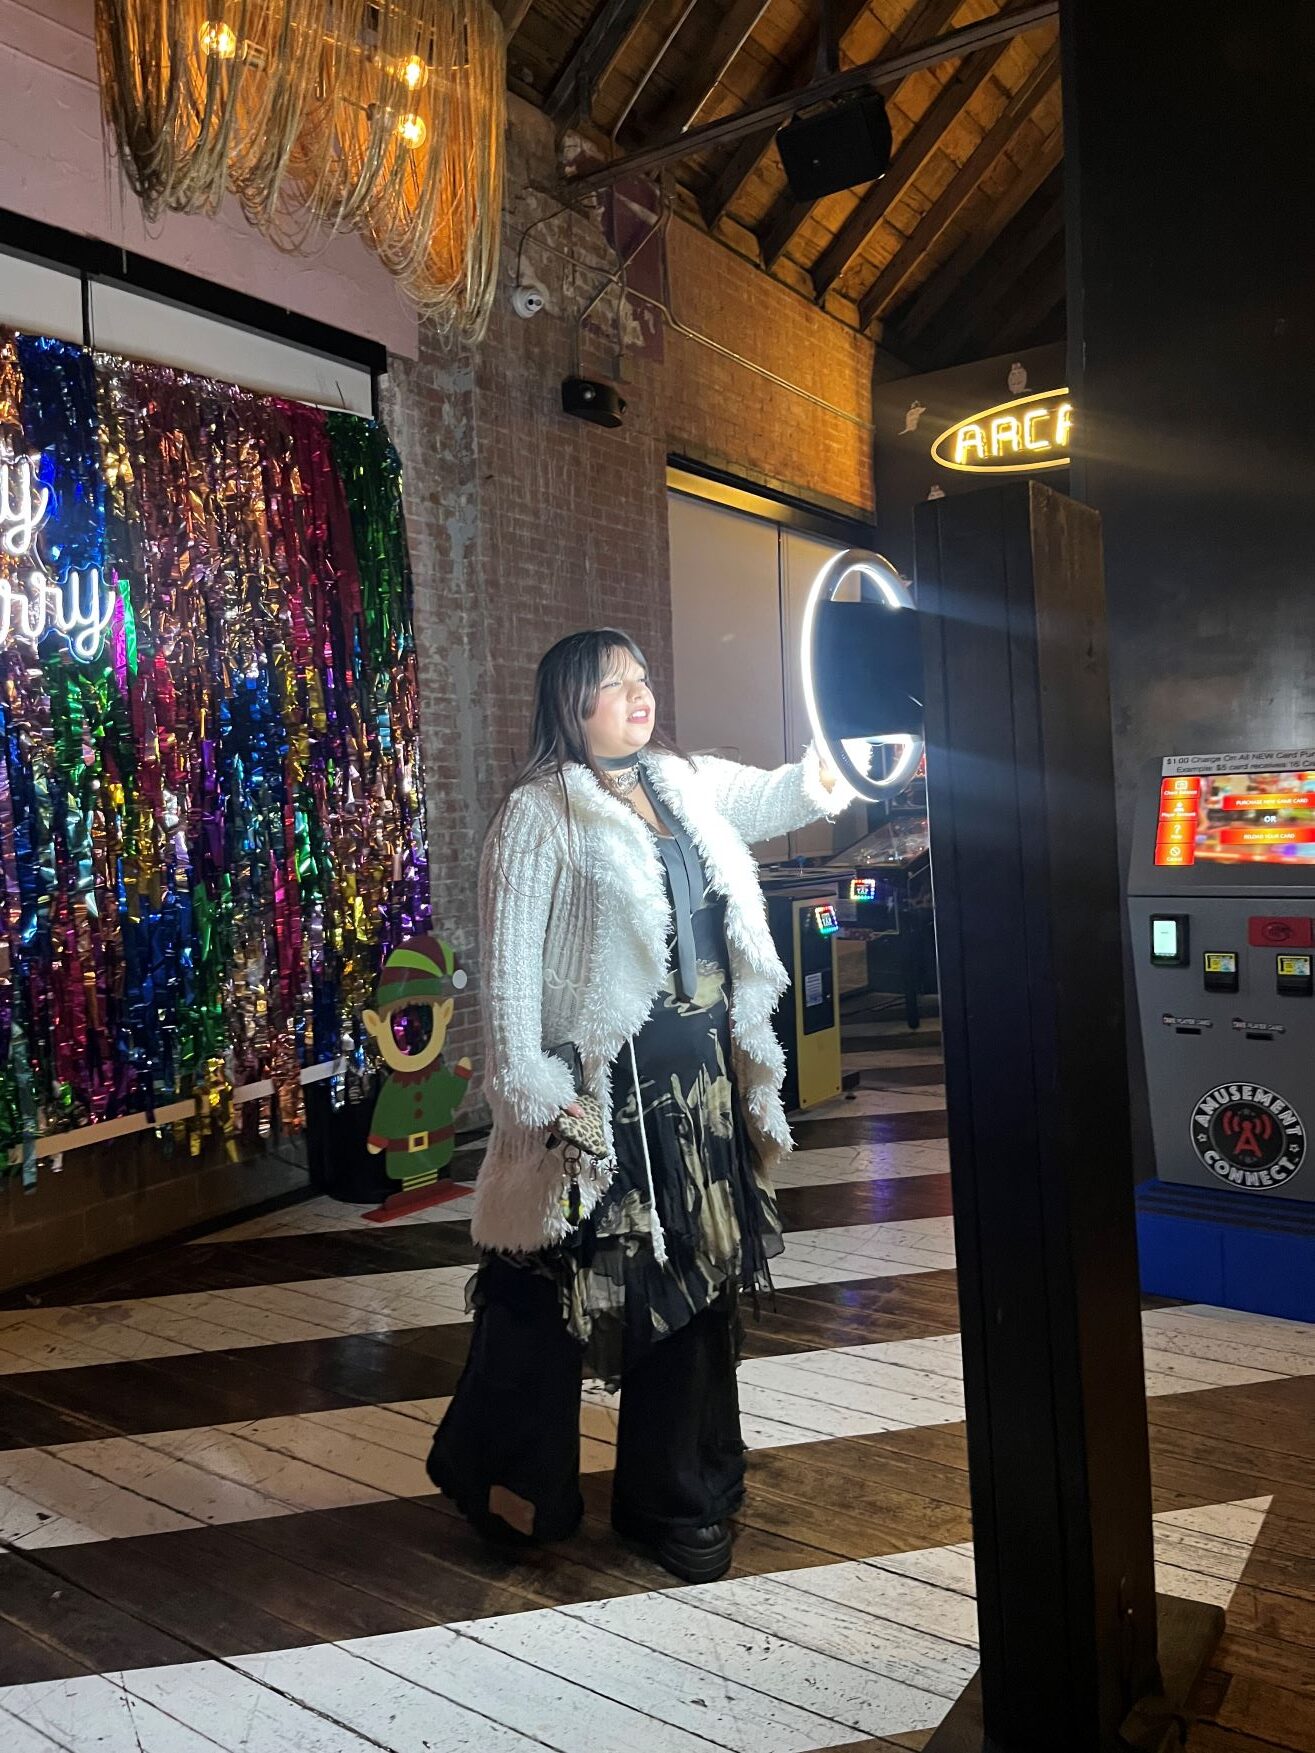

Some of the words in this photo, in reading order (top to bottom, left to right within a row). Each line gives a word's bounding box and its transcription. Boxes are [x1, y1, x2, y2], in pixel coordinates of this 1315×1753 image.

[1190, 756, 1221, 764] Charge
[1251, 752, 1274, 760] NEW
[1276, 751, 1298, 759] Card
[1263, 815, 1277, 823] OR
[856, 887, 869, 895] TAP
[1194, 1085, 1303, 1136] AMUSEMENT
[1203, 1150, 1296, 1187] CONNECT
